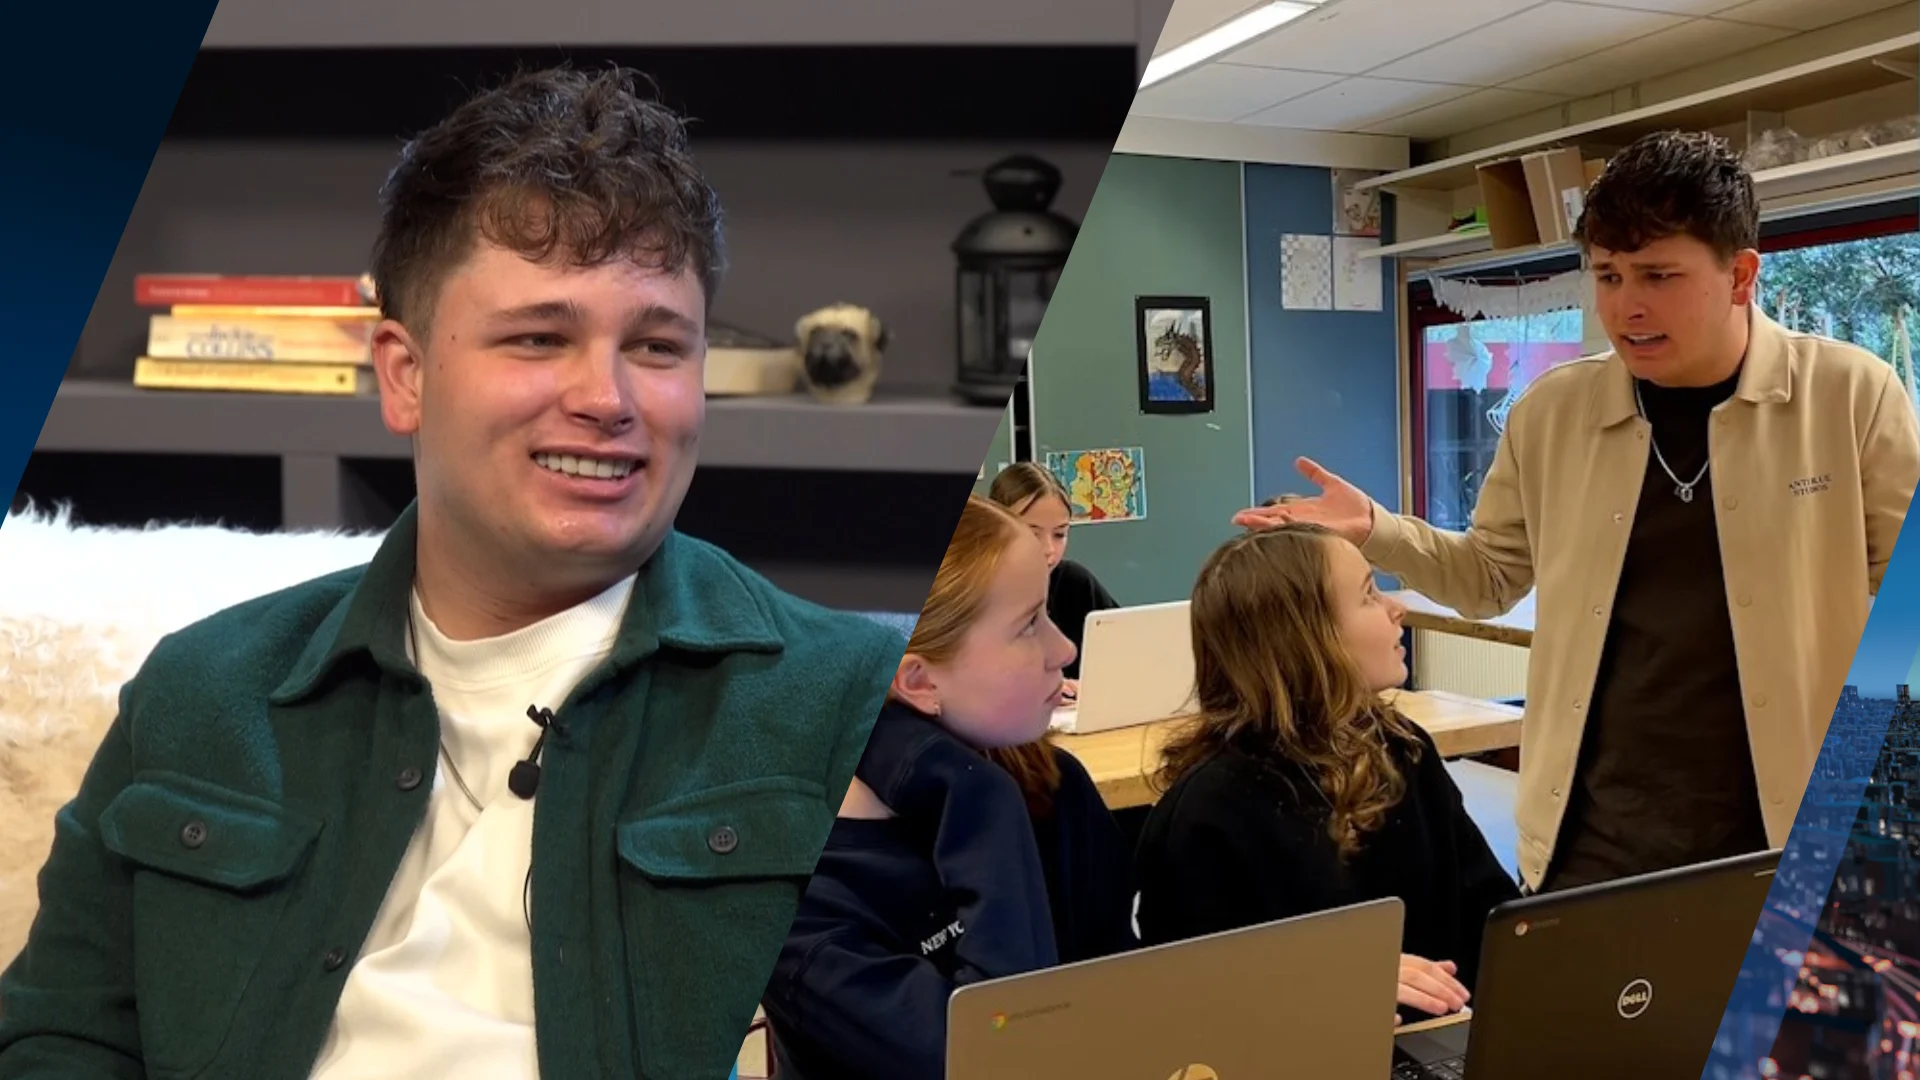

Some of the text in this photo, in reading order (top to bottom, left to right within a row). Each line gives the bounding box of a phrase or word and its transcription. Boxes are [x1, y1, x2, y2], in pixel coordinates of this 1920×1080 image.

[185, 338, 275, 362] COLLINS
[920, 928, 948, 955] NEW
[1622, 991, 1648, 1007] DELL
